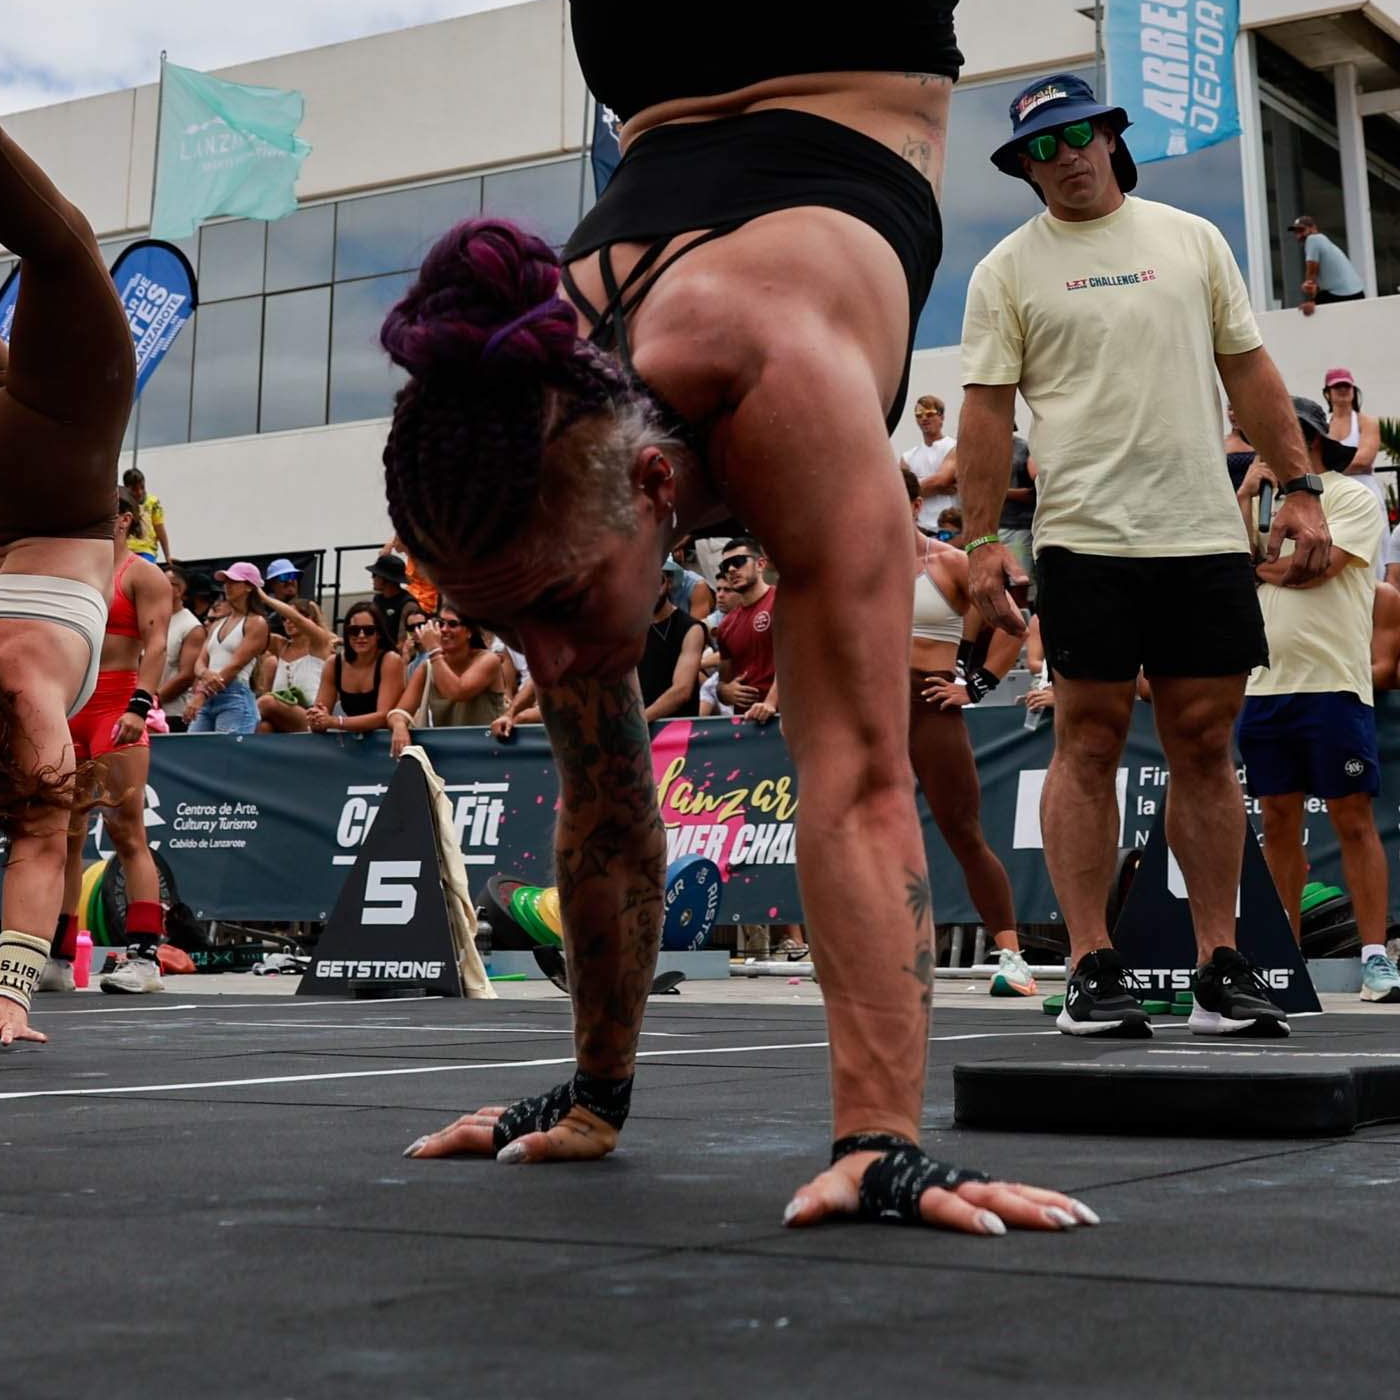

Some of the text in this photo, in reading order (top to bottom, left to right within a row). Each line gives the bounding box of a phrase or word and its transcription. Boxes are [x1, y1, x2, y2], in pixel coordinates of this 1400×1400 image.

[1088, 273, 1140, 288] CHALLENGE
[176, 801, 260, 817] Centros de Arte,
[1137, 796, 1156, 816] la
[173, 817, 210, 831] Cultura
[218, 817, 258, 831] Turismo
[168, 838, 247, 849] Cabildo de Lanzarote
[361, 860, 422, 925] 5
[316, 960, 442, 979] GETSTRONG
